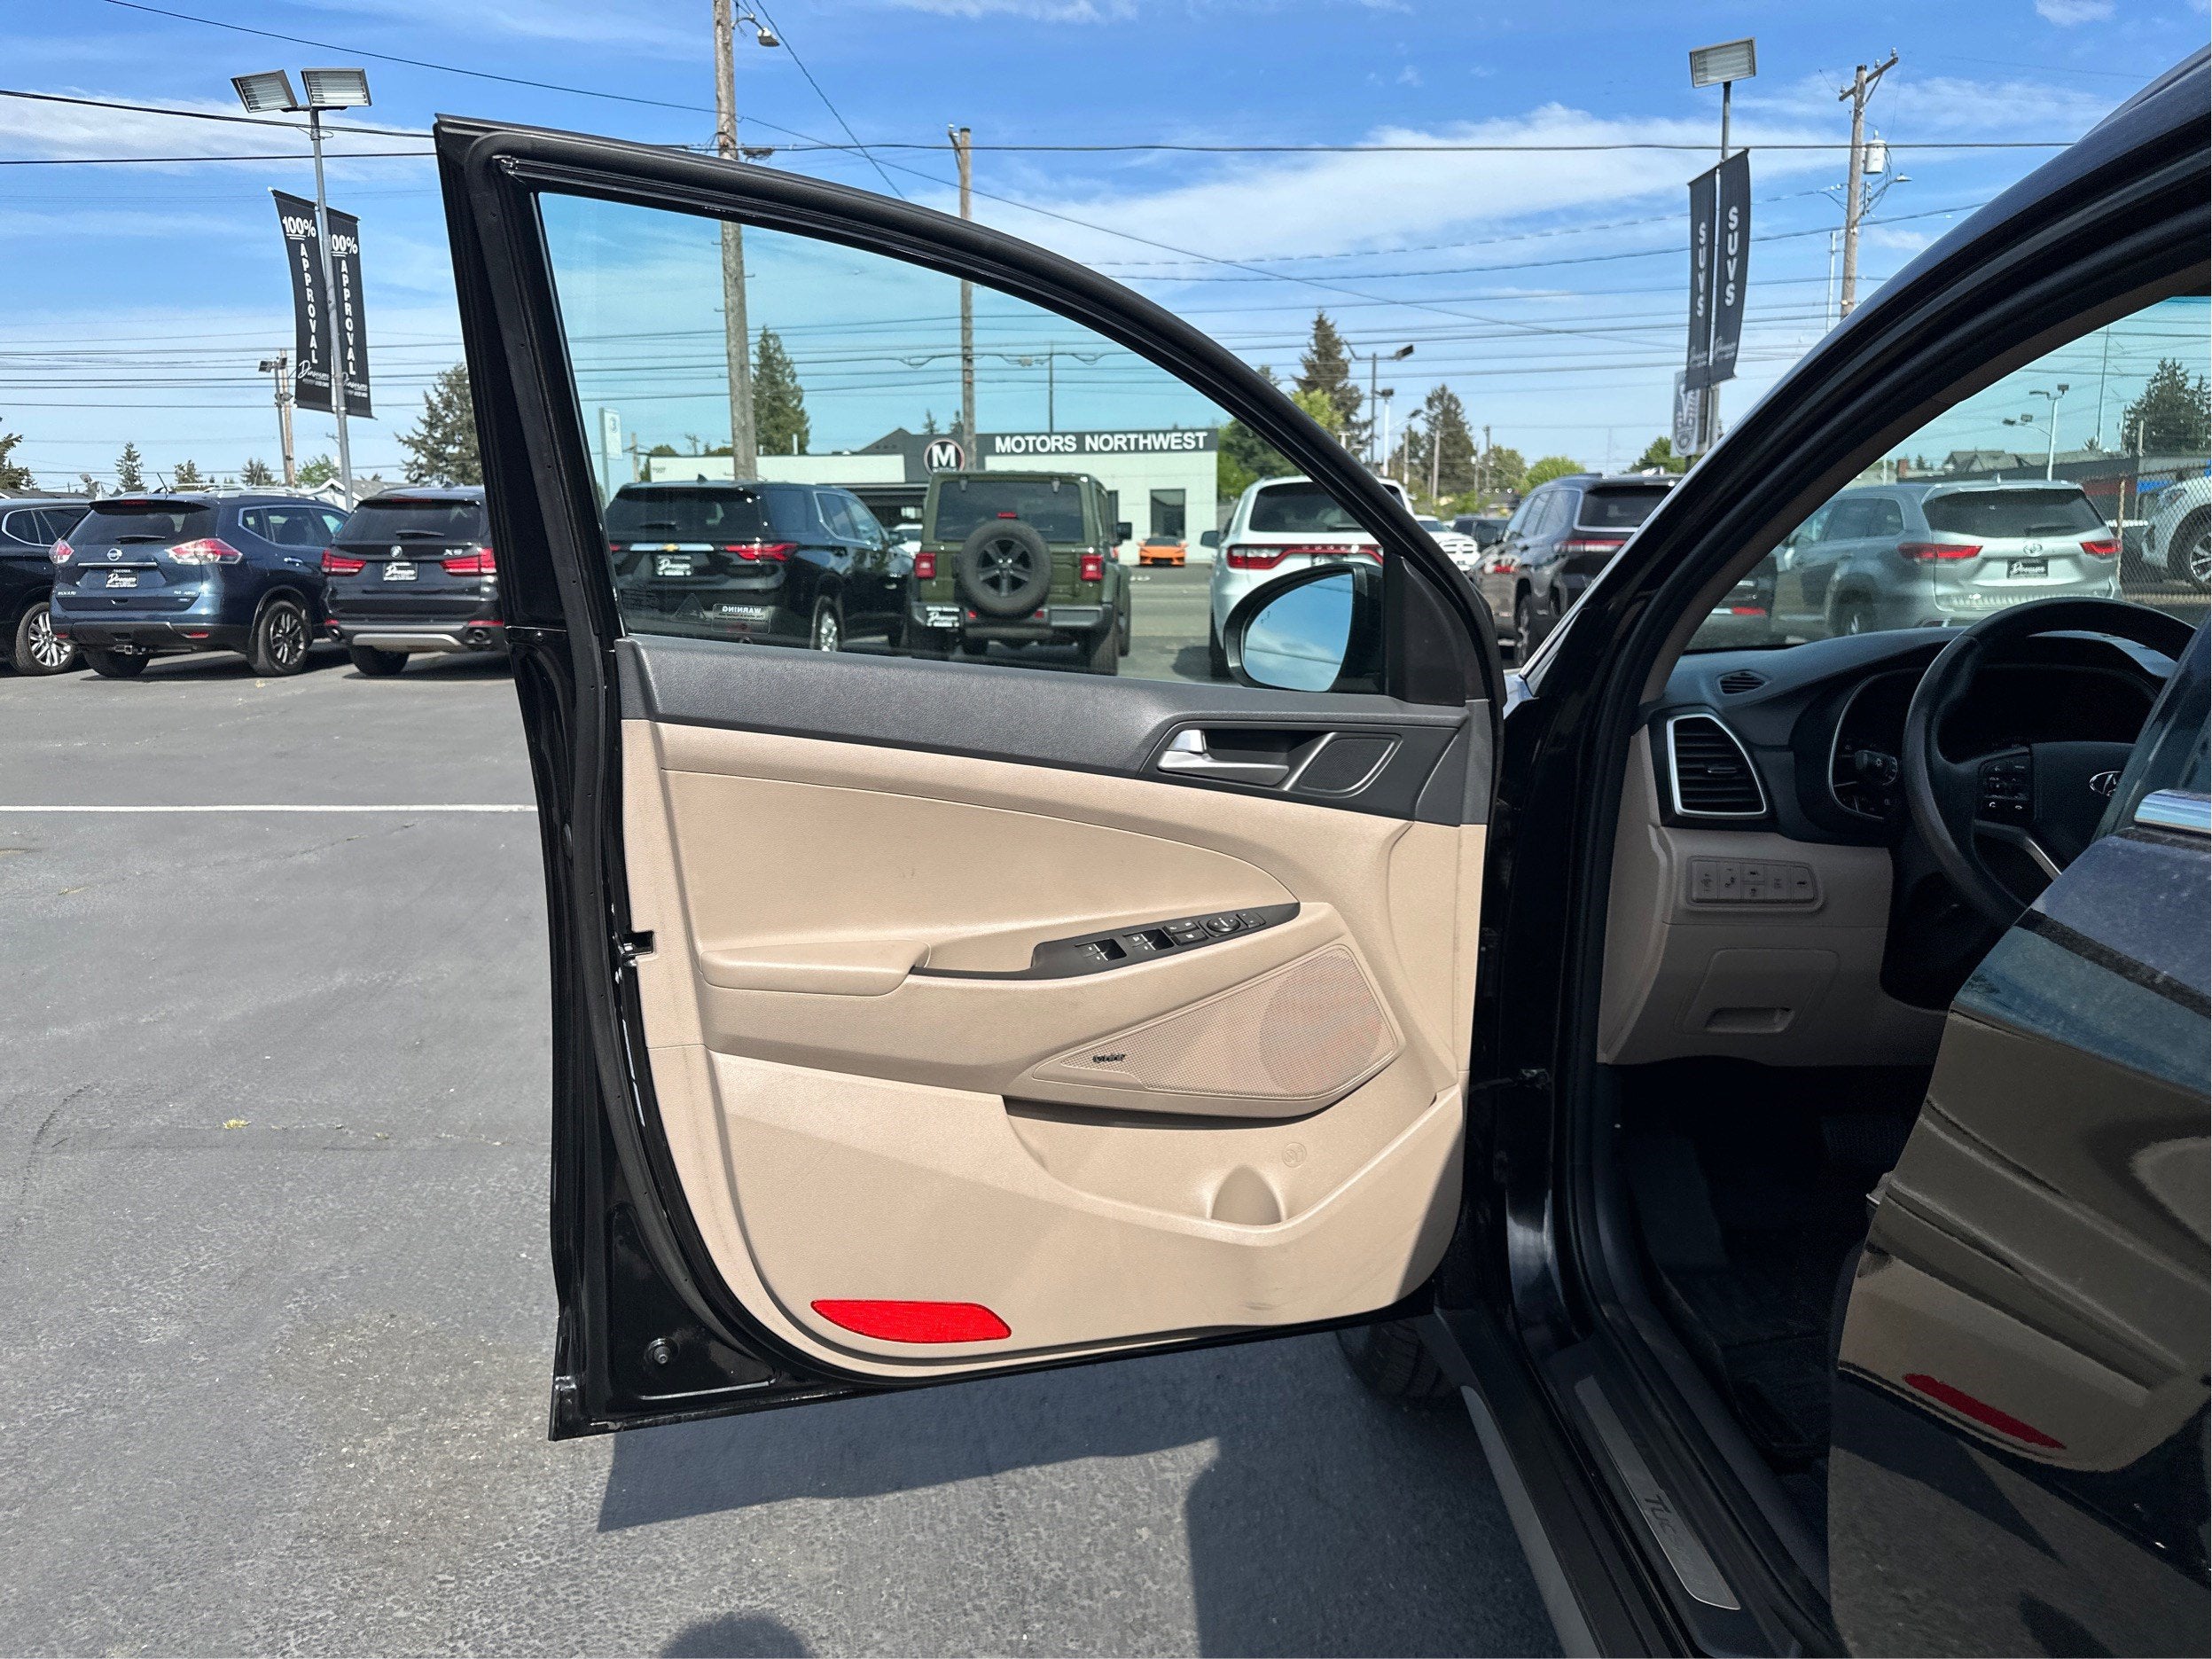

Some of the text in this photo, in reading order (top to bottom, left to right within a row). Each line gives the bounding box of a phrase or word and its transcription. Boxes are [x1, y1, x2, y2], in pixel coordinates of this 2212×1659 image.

[282, 216, 317, 238] 100%
[1696, 223, 1707, 317] SUVS
[1724, 206, 1739, 307] SUVS
[300, 243, 318, 364] APPROVAL
[340, 259, 356, 376] APPROVAL
[931, 443, 957, 467] M
[995, 431, 1208, 454] MOTORS NORTHWEST
